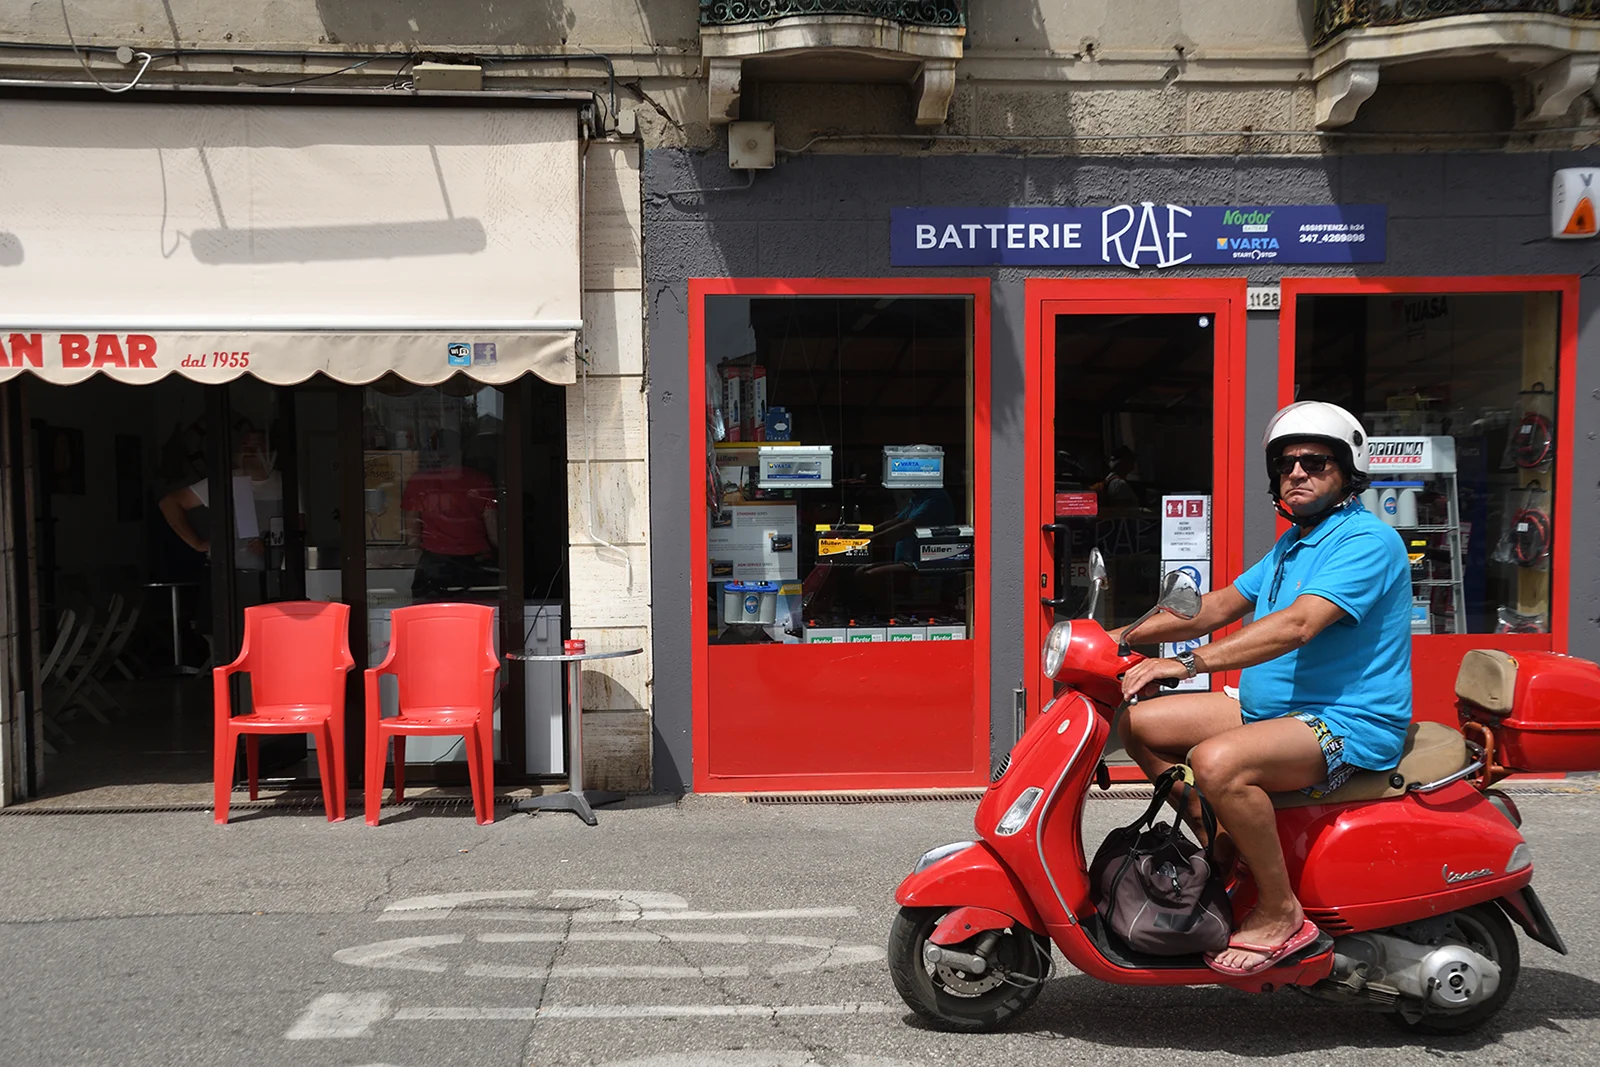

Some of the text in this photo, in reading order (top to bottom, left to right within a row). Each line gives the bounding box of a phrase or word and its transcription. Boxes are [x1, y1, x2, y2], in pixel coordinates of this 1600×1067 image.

[1222, 210, 1272, 225] Nordor
[916, 202, 1192, 269] BATTERIE RAE
[1229, 238, 1280, 249] VARTA
[1250, 293, 1279, 306] 1128
[1404, 296, 1448, 323] YUASA
[0, 333, 158, 368] N BAR
[181, 352, 250, 368] dal 1955
[1368, 442, 1424, 455] OPTIMA
[1191, 504, 1198, 513] 1
[1442, 864, 1495, 884] Vespa
